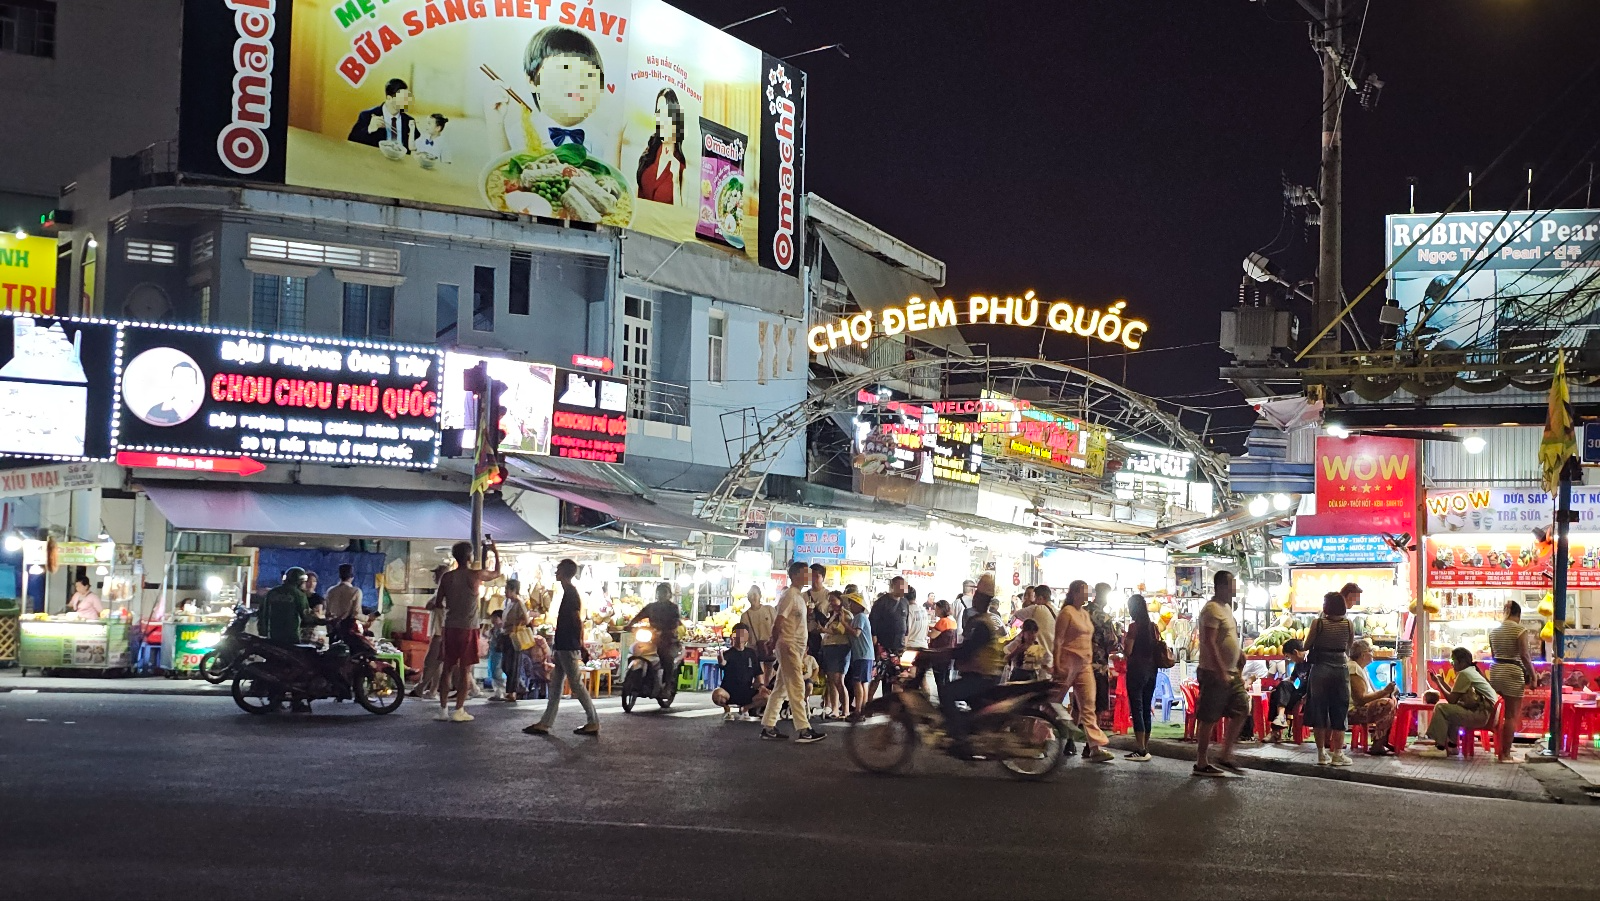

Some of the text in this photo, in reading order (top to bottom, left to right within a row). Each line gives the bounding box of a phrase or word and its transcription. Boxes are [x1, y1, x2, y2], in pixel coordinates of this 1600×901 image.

[339, 25, 403, 85] BỮA
[705, 134, 739, 162] Omachi
[774, 97, 795, 269] Omachi
[1393, 219, 1534, 247] ROBINSON
[1417, 248, 1457, 264] Ngọc
[1501, 245, 1541, 260] Pearl
[807, 290, 1148, 353] CHỢ ĐÊM PHÚ QUỐC
[347, 349, 391, 375] ÔNG
[396, 354, 431, 378] TÂY
[211, 372, 437, 419] CHOU CHOU PHÚ QUỐC
[2, 470, 26, 492] XÍU
[81, 464, 88, 472] 2
[1321, 454, 1410, 481] WOW
[1426, 490, 1491, 515] WOW
[1503, 492, 1524, 504] DỪA
[1520, 507, 1541, 521] SỮA
[1285, 538, 1323, 552] WOW
